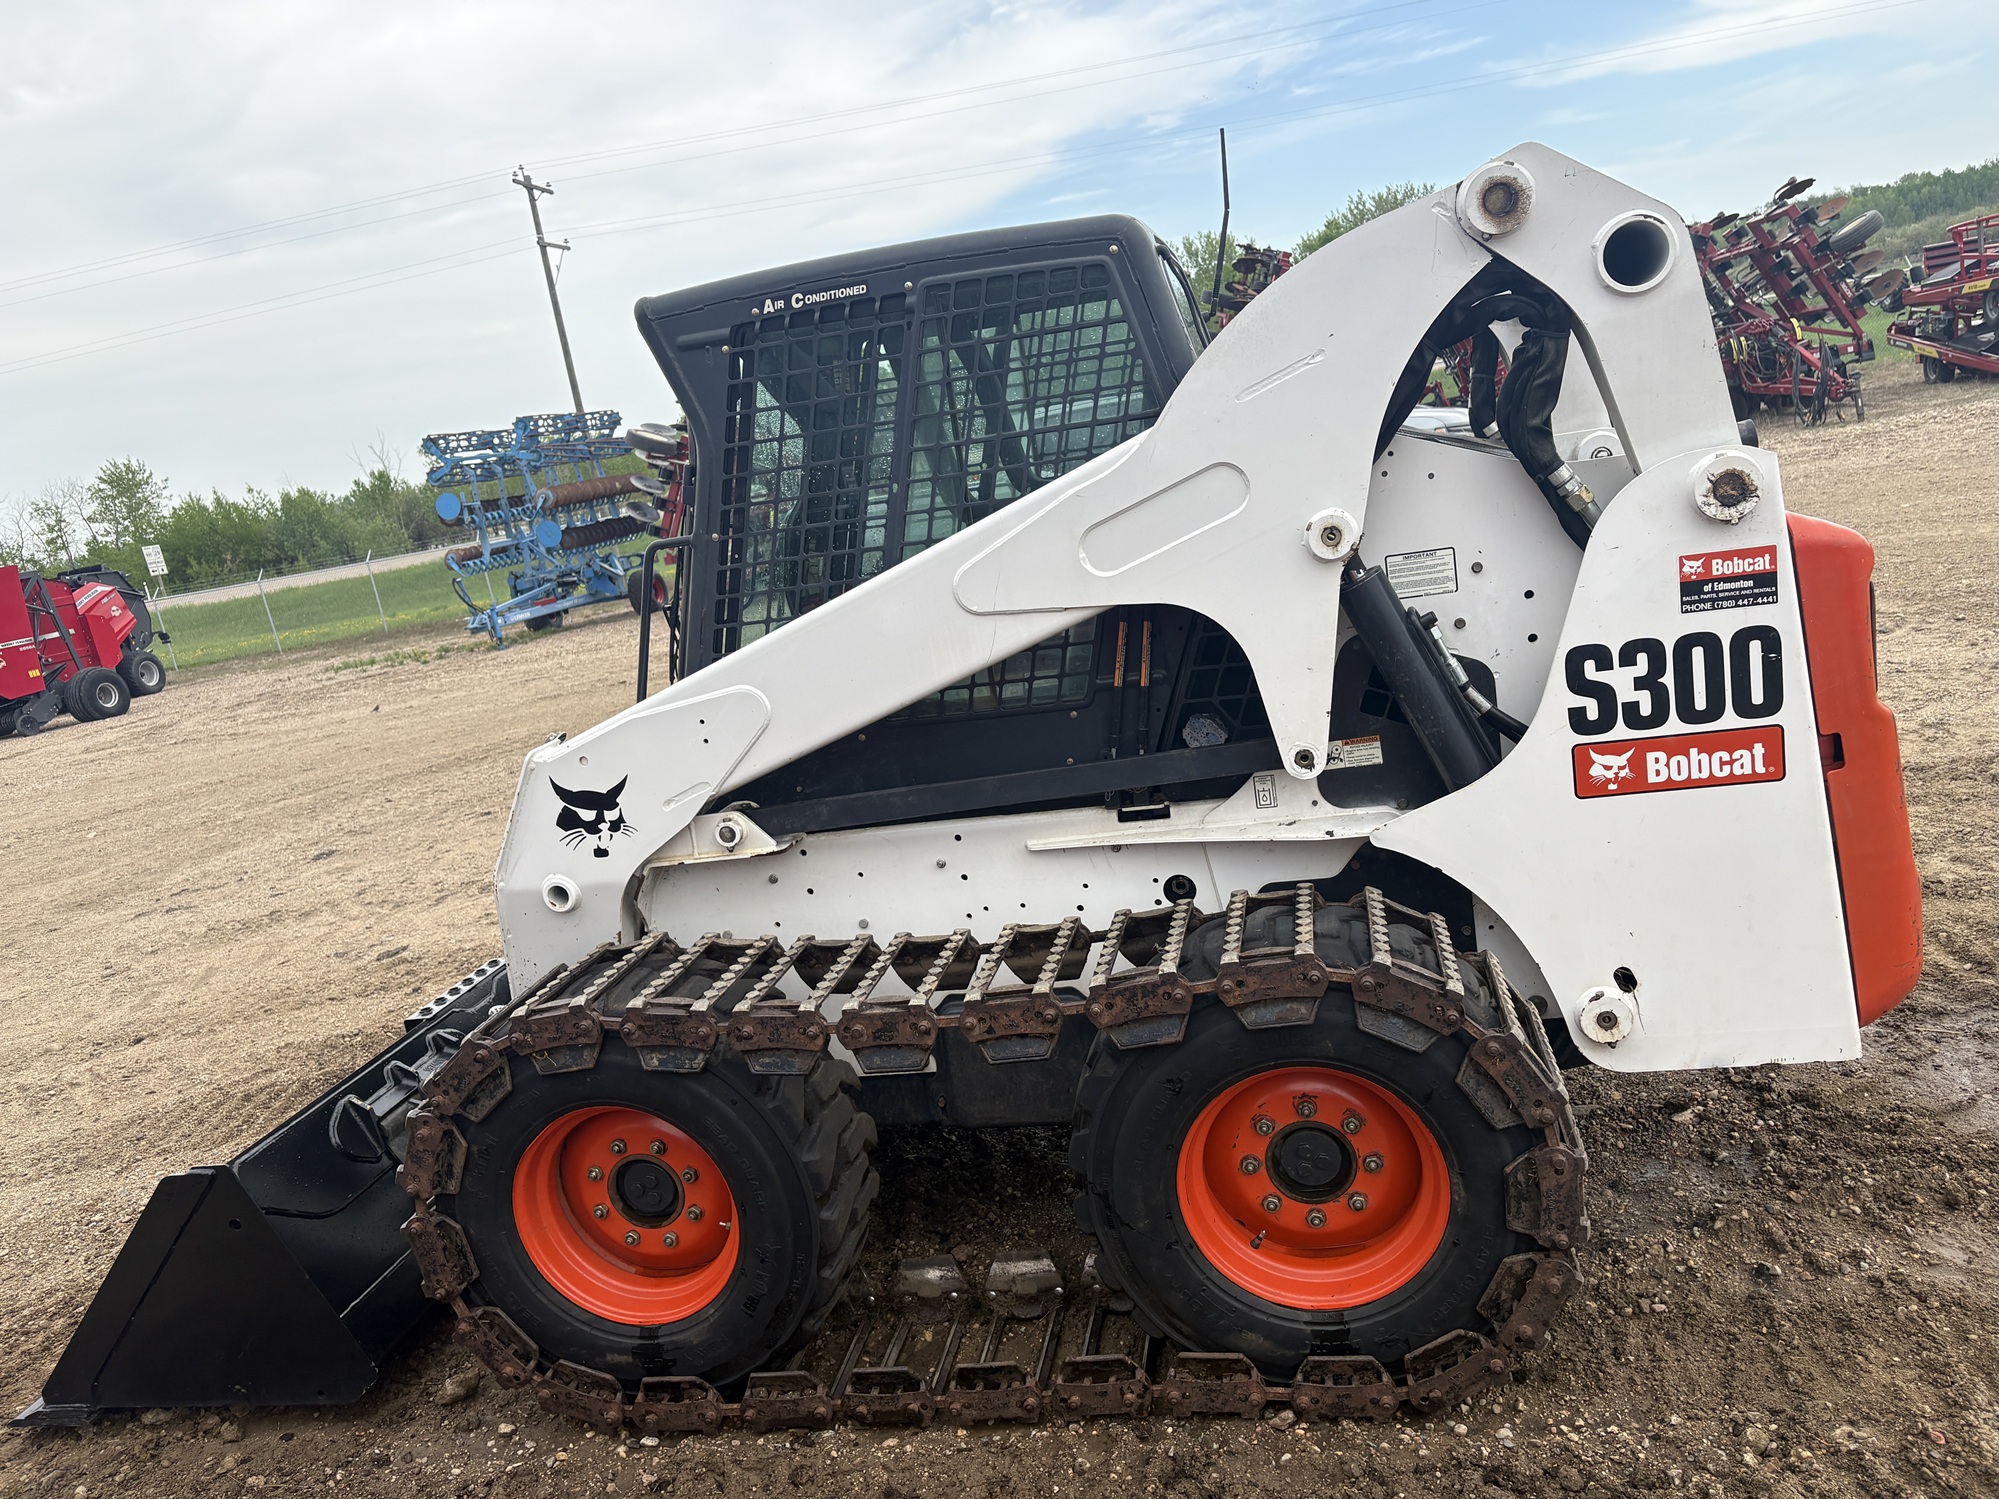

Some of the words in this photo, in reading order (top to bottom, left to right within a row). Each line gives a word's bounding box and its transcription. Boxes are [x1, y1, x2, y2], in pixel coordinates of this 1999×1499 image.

[1402, 551, 1438, 561] IMPORTANT
[1711, 553, 1771, 576] Bobcat
[1703, 581, 1712, 592] of
[1713, 579, 1754, 591] Edmonton
[1718, 590, 1740, 598] SERVICE
[1753, 586, 1776, 594] RENTALS
[1682, 602, 1713, 613] PHONE
[1714, 599, 1736, 610] (780)
[1737, 595, 1777, 607] 447-4441
[1564, 624, 1784, 737] S300
[1645, 742, 1766, 784] Bobcat
